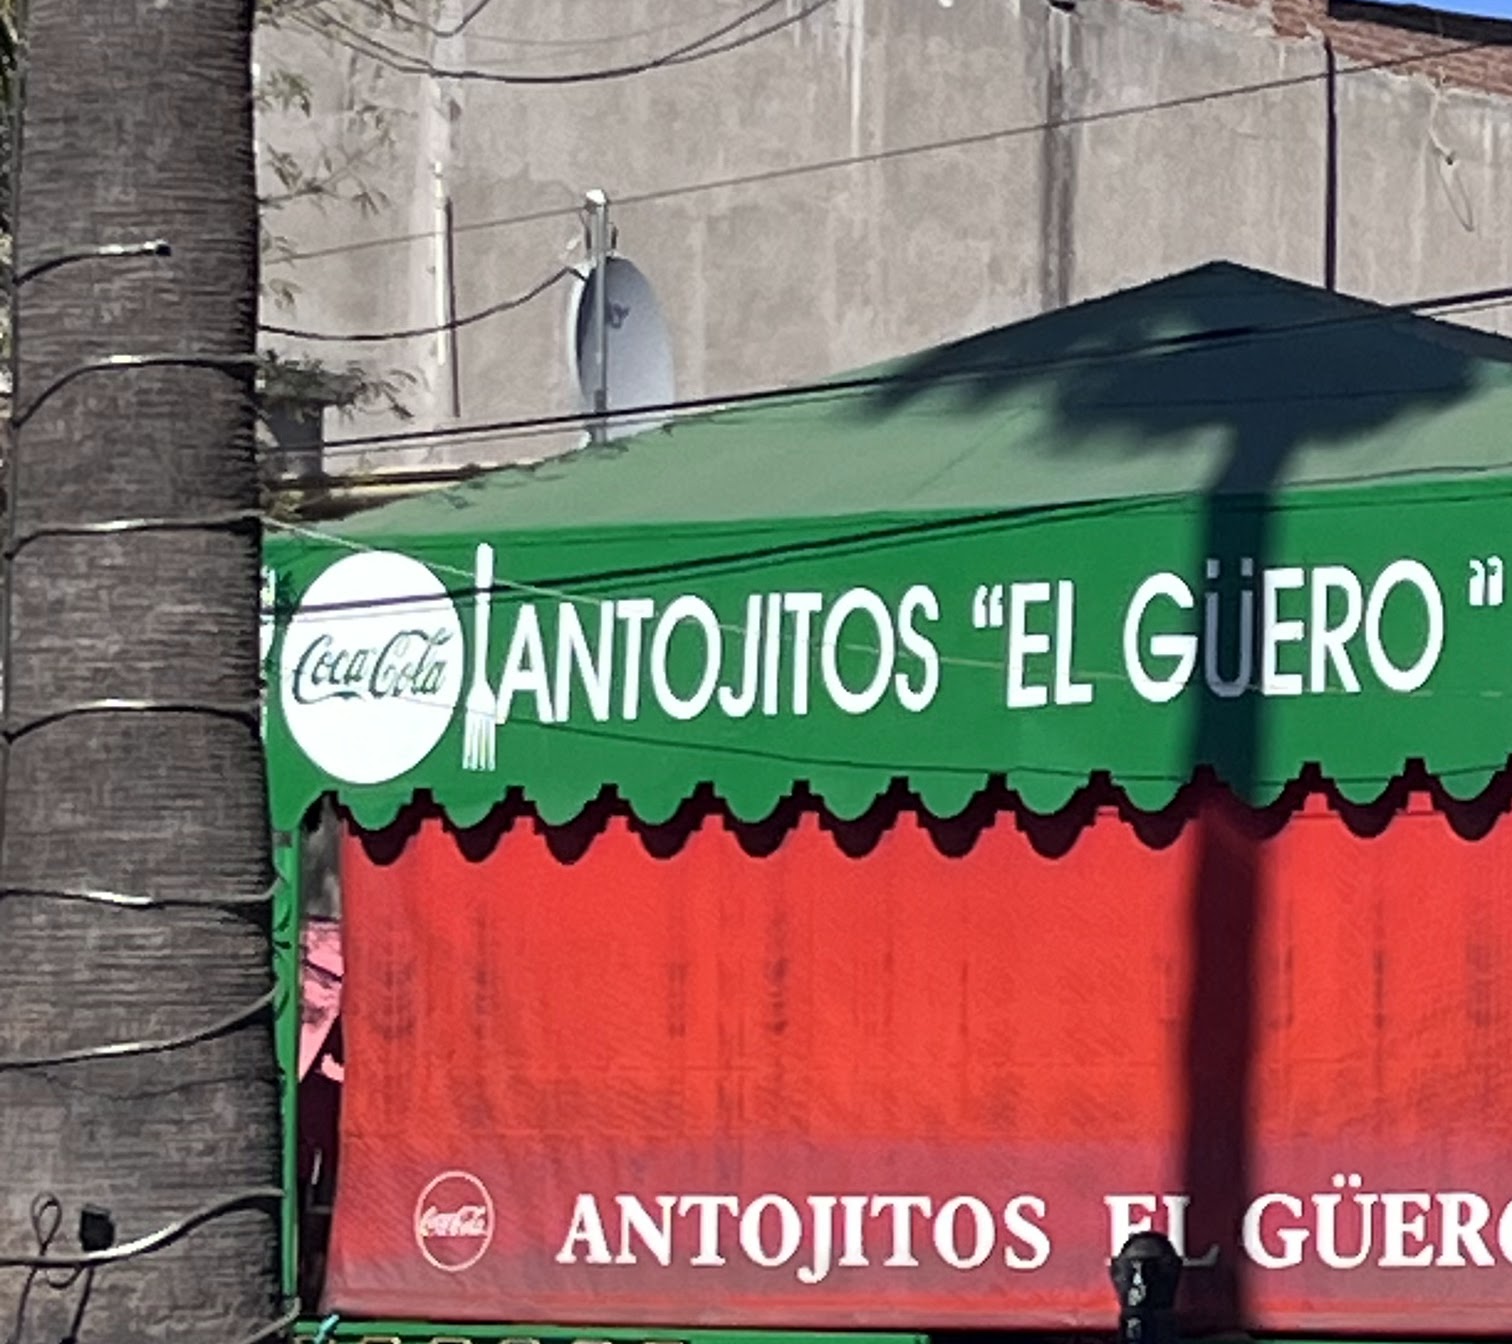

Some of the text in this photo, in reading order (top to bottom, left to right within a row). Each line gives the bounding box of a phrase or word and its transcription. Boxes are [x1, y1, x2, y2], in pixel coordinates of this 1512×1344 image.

[498, 584, 940, 726] ANTOJITOS
[972, 578, 1094, 710] “EL
[555, 1193, 1052, 1285] ANTOJITOS
[1103, 1194, 1222, 1268] EL
